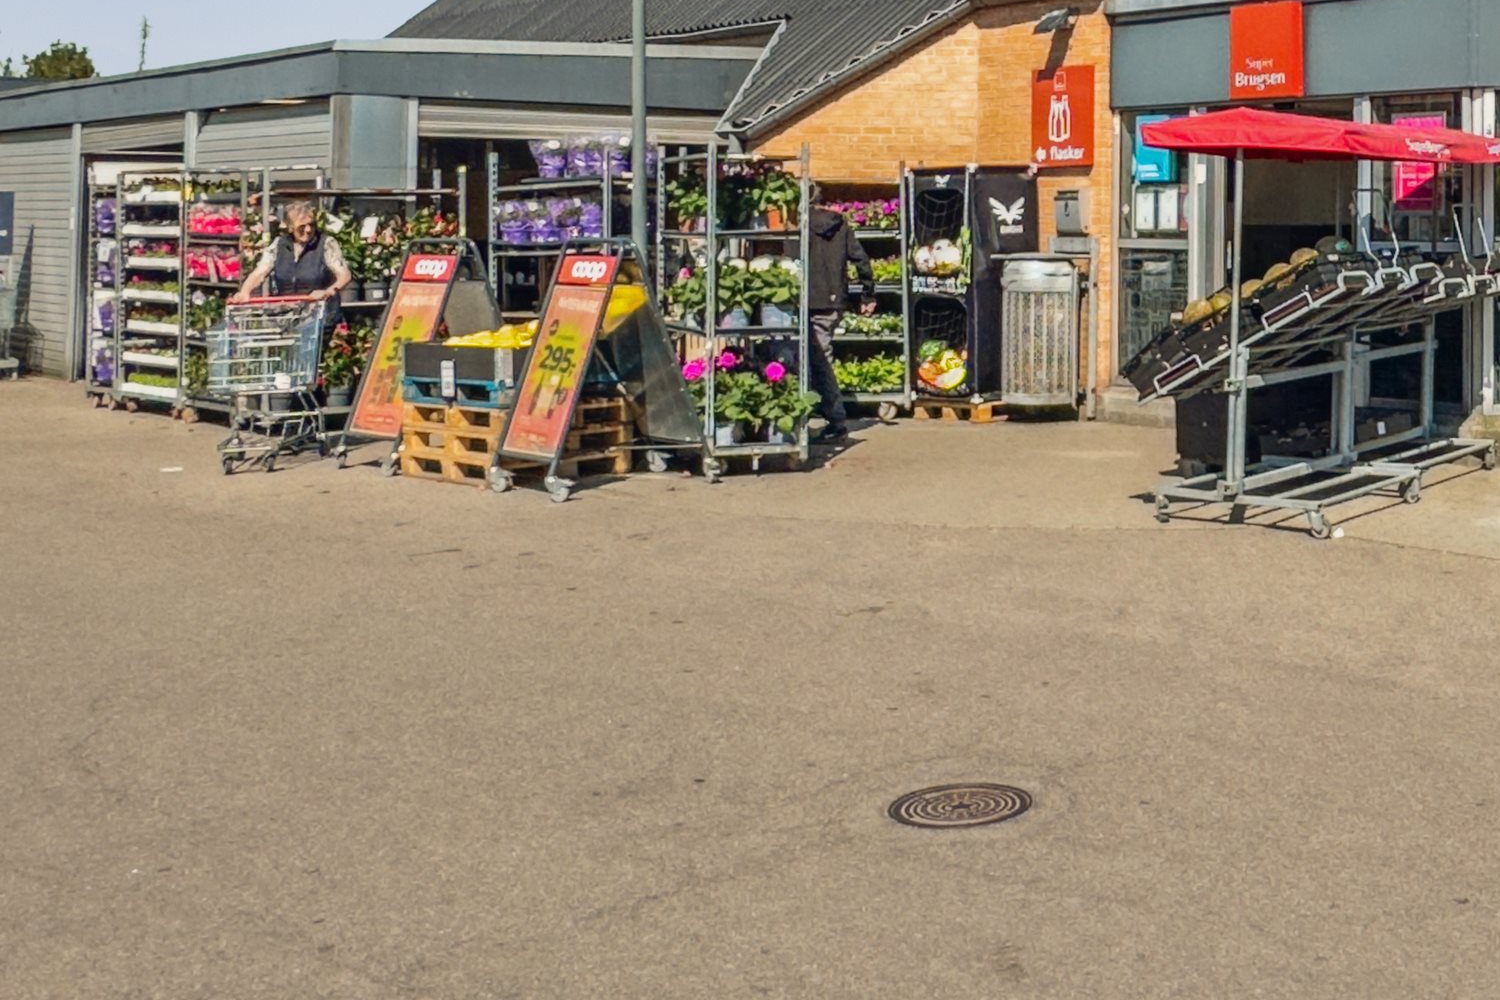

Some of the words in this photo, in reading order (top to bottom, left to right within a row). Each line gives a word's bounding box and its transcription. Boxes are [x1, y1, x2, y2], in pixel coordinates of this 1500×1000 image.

[1235, 72, 1286, 91] Brugsen
[1050, 146, 1085, 160] flasker
[415, 259, 448, 278] coop
[571, 260, 607, 281] coop
